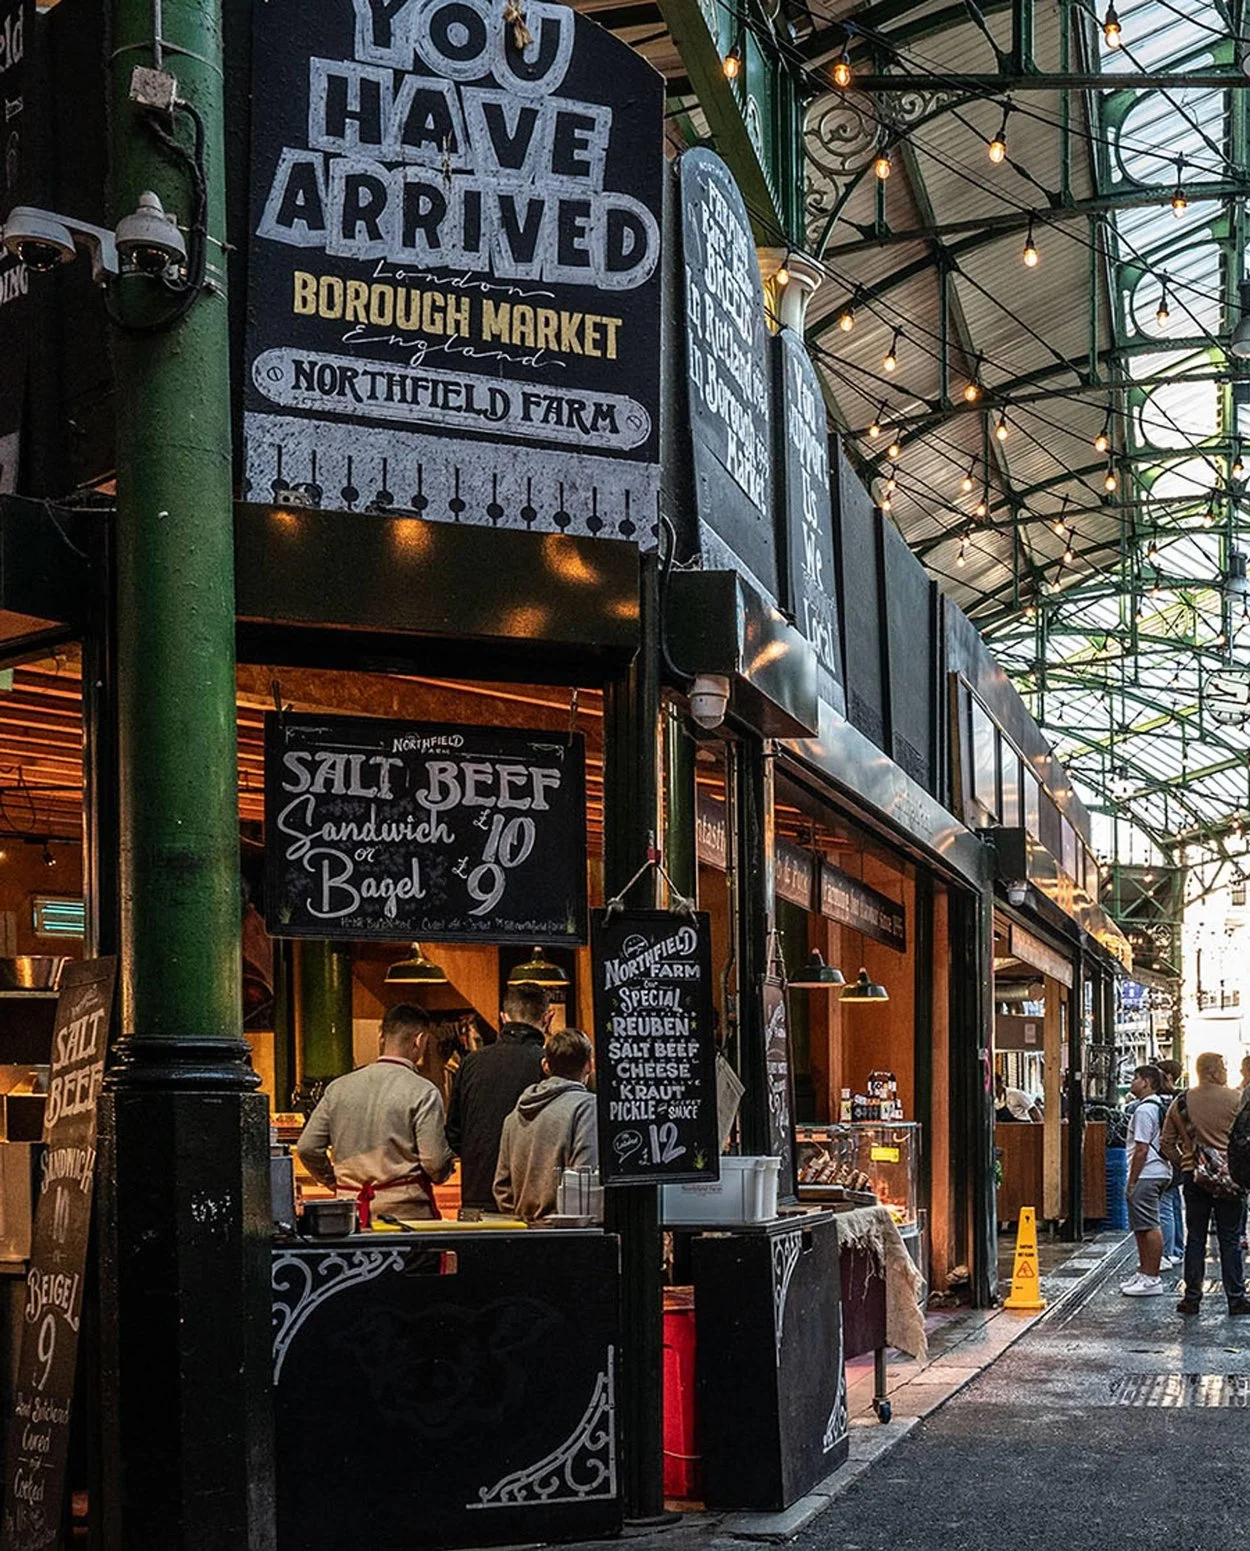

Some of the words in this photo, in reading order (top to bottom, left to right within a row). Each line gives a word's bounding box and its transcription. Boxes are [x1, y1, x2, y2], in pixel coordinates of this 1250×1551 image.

[354, 0, 574, 95] YOU
[308, 58, 611, 187] HAVE
[257, 147, 659, 290] ARRIVED
[373, 260, 555, 298] London
[293, 271, 470, 337] BOROUGH
[482, 299, 623, 359] MARKET
[341, 325, 565, 368] England
[703, 293, 753, 404] Rutland
[292, 359, 510, 422] NORTHFIELD
[520, 395, 618, 434] FARM
[704, 353, 756, 467] Borough
[793, 356, 817, 434] You
[727, 427, 766, 515] Market
[801, 466, 818, 530] Us
[801, 520, 824, 591] We
[803, 596, 836, 675] Local
[392, 735, 464, 753] NORTHFIELD
[281, 751, 404, 800] SALT
[415, 761, 561, 811] BEEF
[277, 794, 455, 861] Sandwich
[473, 808, 536, 868] £10
[355, 846, 377, 862] or
[303, 847, 426, 919] Bagel
[451, 856, 506, 916] £9
[604, 926, 698, 990] NORTHFIELD
[650, 963, 700, 978] FARM
[612, 1016, 690, 1037] REUBEN
[618, 987, 684, 1013] SPECIAL
[53, 1008, 104, 1071] SALT
[608, 1042, 651, 1059] SALT
[654, 1042, 700, 1058] BEEF
[616, 1063, 691, 1079] CHEESE
[45, 1060, 104, 1129] BEEF
[610, 1100, 656, 1121] PICKLE
[668, 1105, 698, 1120] SAUCE
[620, 1084, 685, 1100] KRAUT
[40, 1147, 97, 1195] SANDWICH
[25, 1267, 80, 1333] BEIGEL
